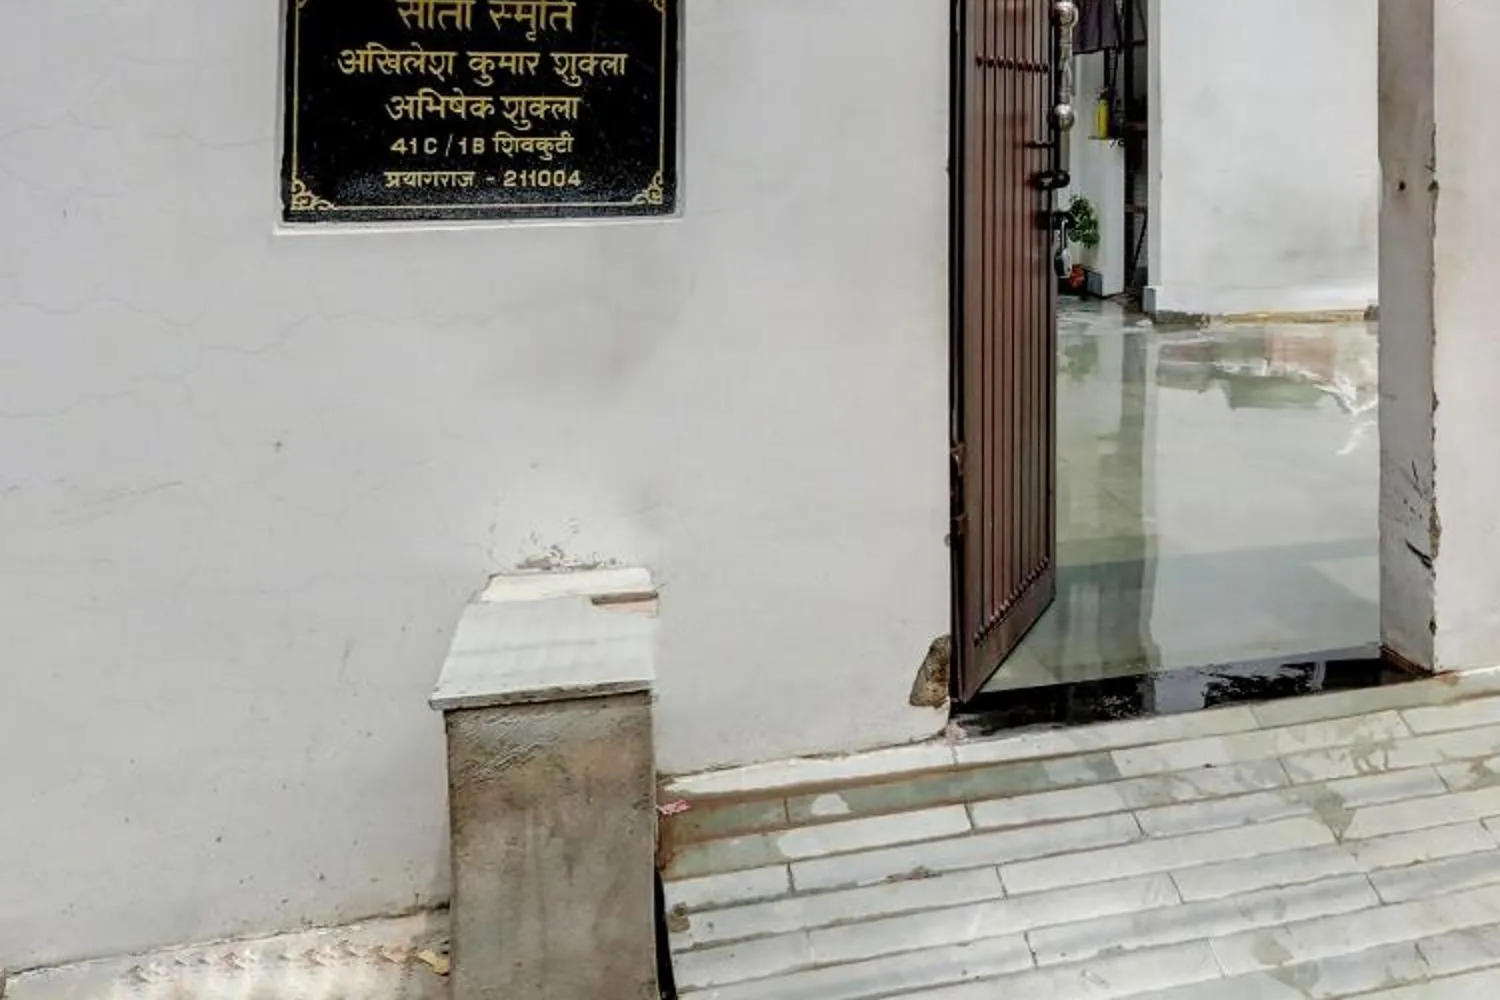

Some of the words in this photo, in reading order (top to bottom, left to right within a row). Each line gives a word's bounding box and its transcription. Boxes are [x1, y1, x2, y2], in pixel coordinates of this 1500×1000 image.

[337, 41, 458, 82] अखिलेश
[466, 51, 541, 87] कुमार
[549, 53, 629, 87] शुक्ला
[384, 87, 494, 120] अभिषेक
[499, 96, 582, 131] शुक्ला
[492, 131, 575, 161] शिवकुटी
[383, 171, 476, 188] प्रयागराज
[503, 169, 582, 187] 211004
